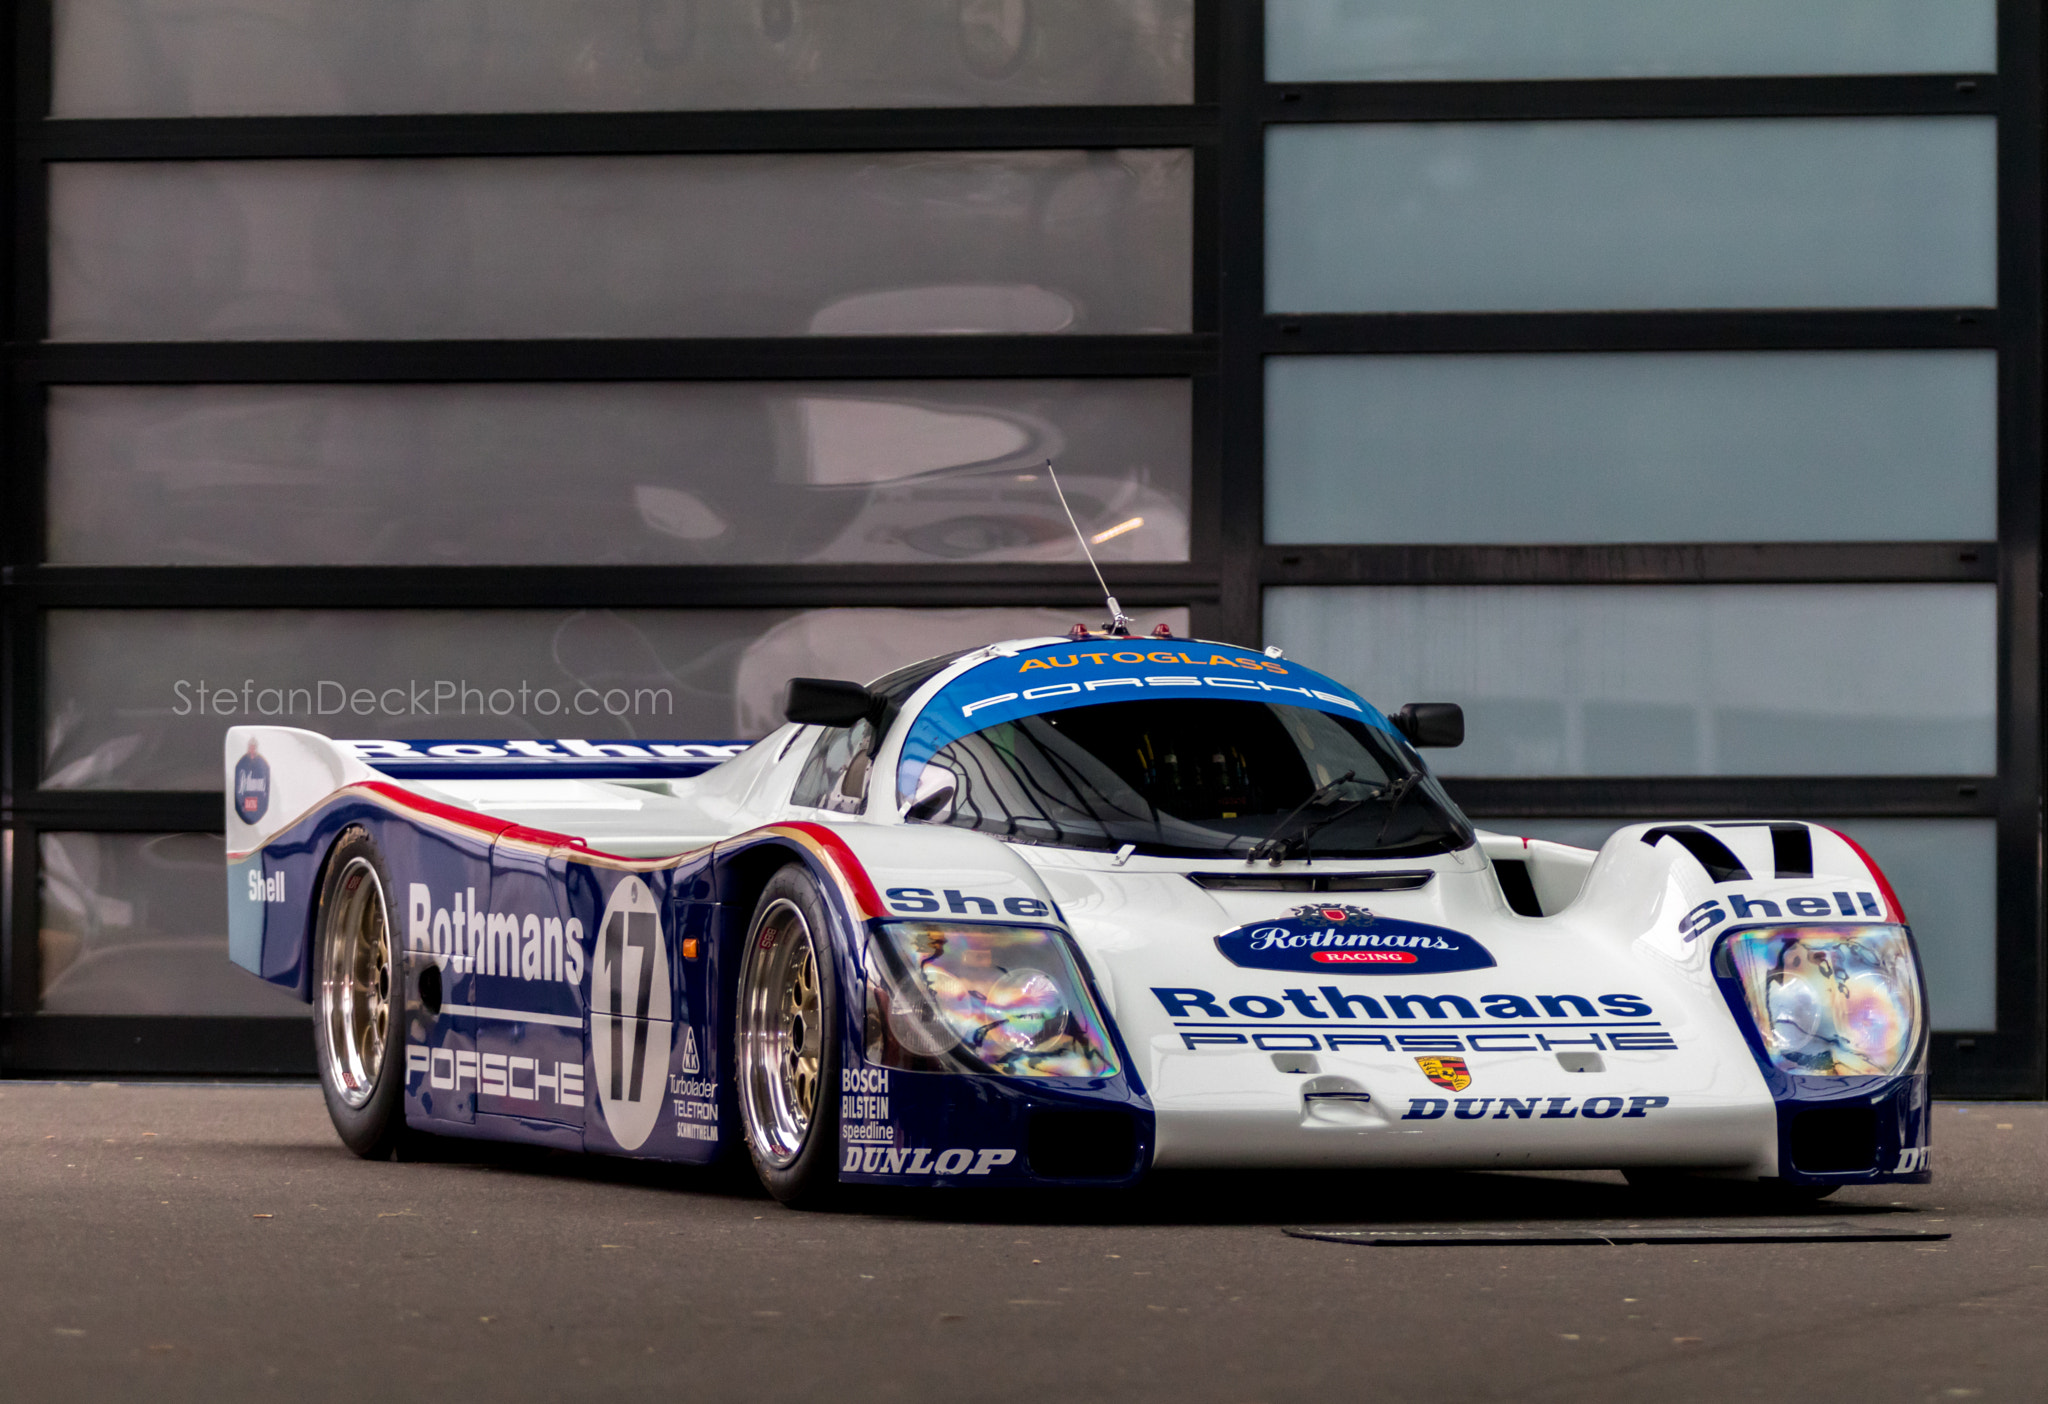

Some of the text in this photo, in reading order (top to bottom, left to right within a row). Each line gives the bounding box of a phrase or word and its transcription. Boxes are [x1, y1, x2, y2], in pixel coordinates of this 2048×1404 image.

[1018, 651, 1289, 674] AUTOGLASS
[961, 675, 1363, 718] PORSCHE
[334, 739, 750, 757] Rothm
[248, 869, 285, 902] Shell
[886, 888, 1068, 927] She
[1678, 891, 1882, 943] Shell
[409, 882, 584, 985] Rothmans
[1250, 927, 1459, 950] Rothmans
[1325, 953, 1403, 962] RACING
[604, 910, 657, 1102] 17
[1150, 986, 1653, 1019] Rothmans
[1180, 1032, 1678, 1053] PORSCHE
[405, 1044, 584, 1107] PORSCHE
[670, 1074, 718, 1098] Turbolader
[842, 1068, 889, 1094] BOSCH
[673, 1099, 718, 1120] TELETRON
[842, 1096, 889, 1120] BILSTEIN
[1401, 1095, 1670, 1120] DUNLOP
[842, 1122, 893, 1142] speedline
[843, 1148, 1016, 1175] DUNLOP
